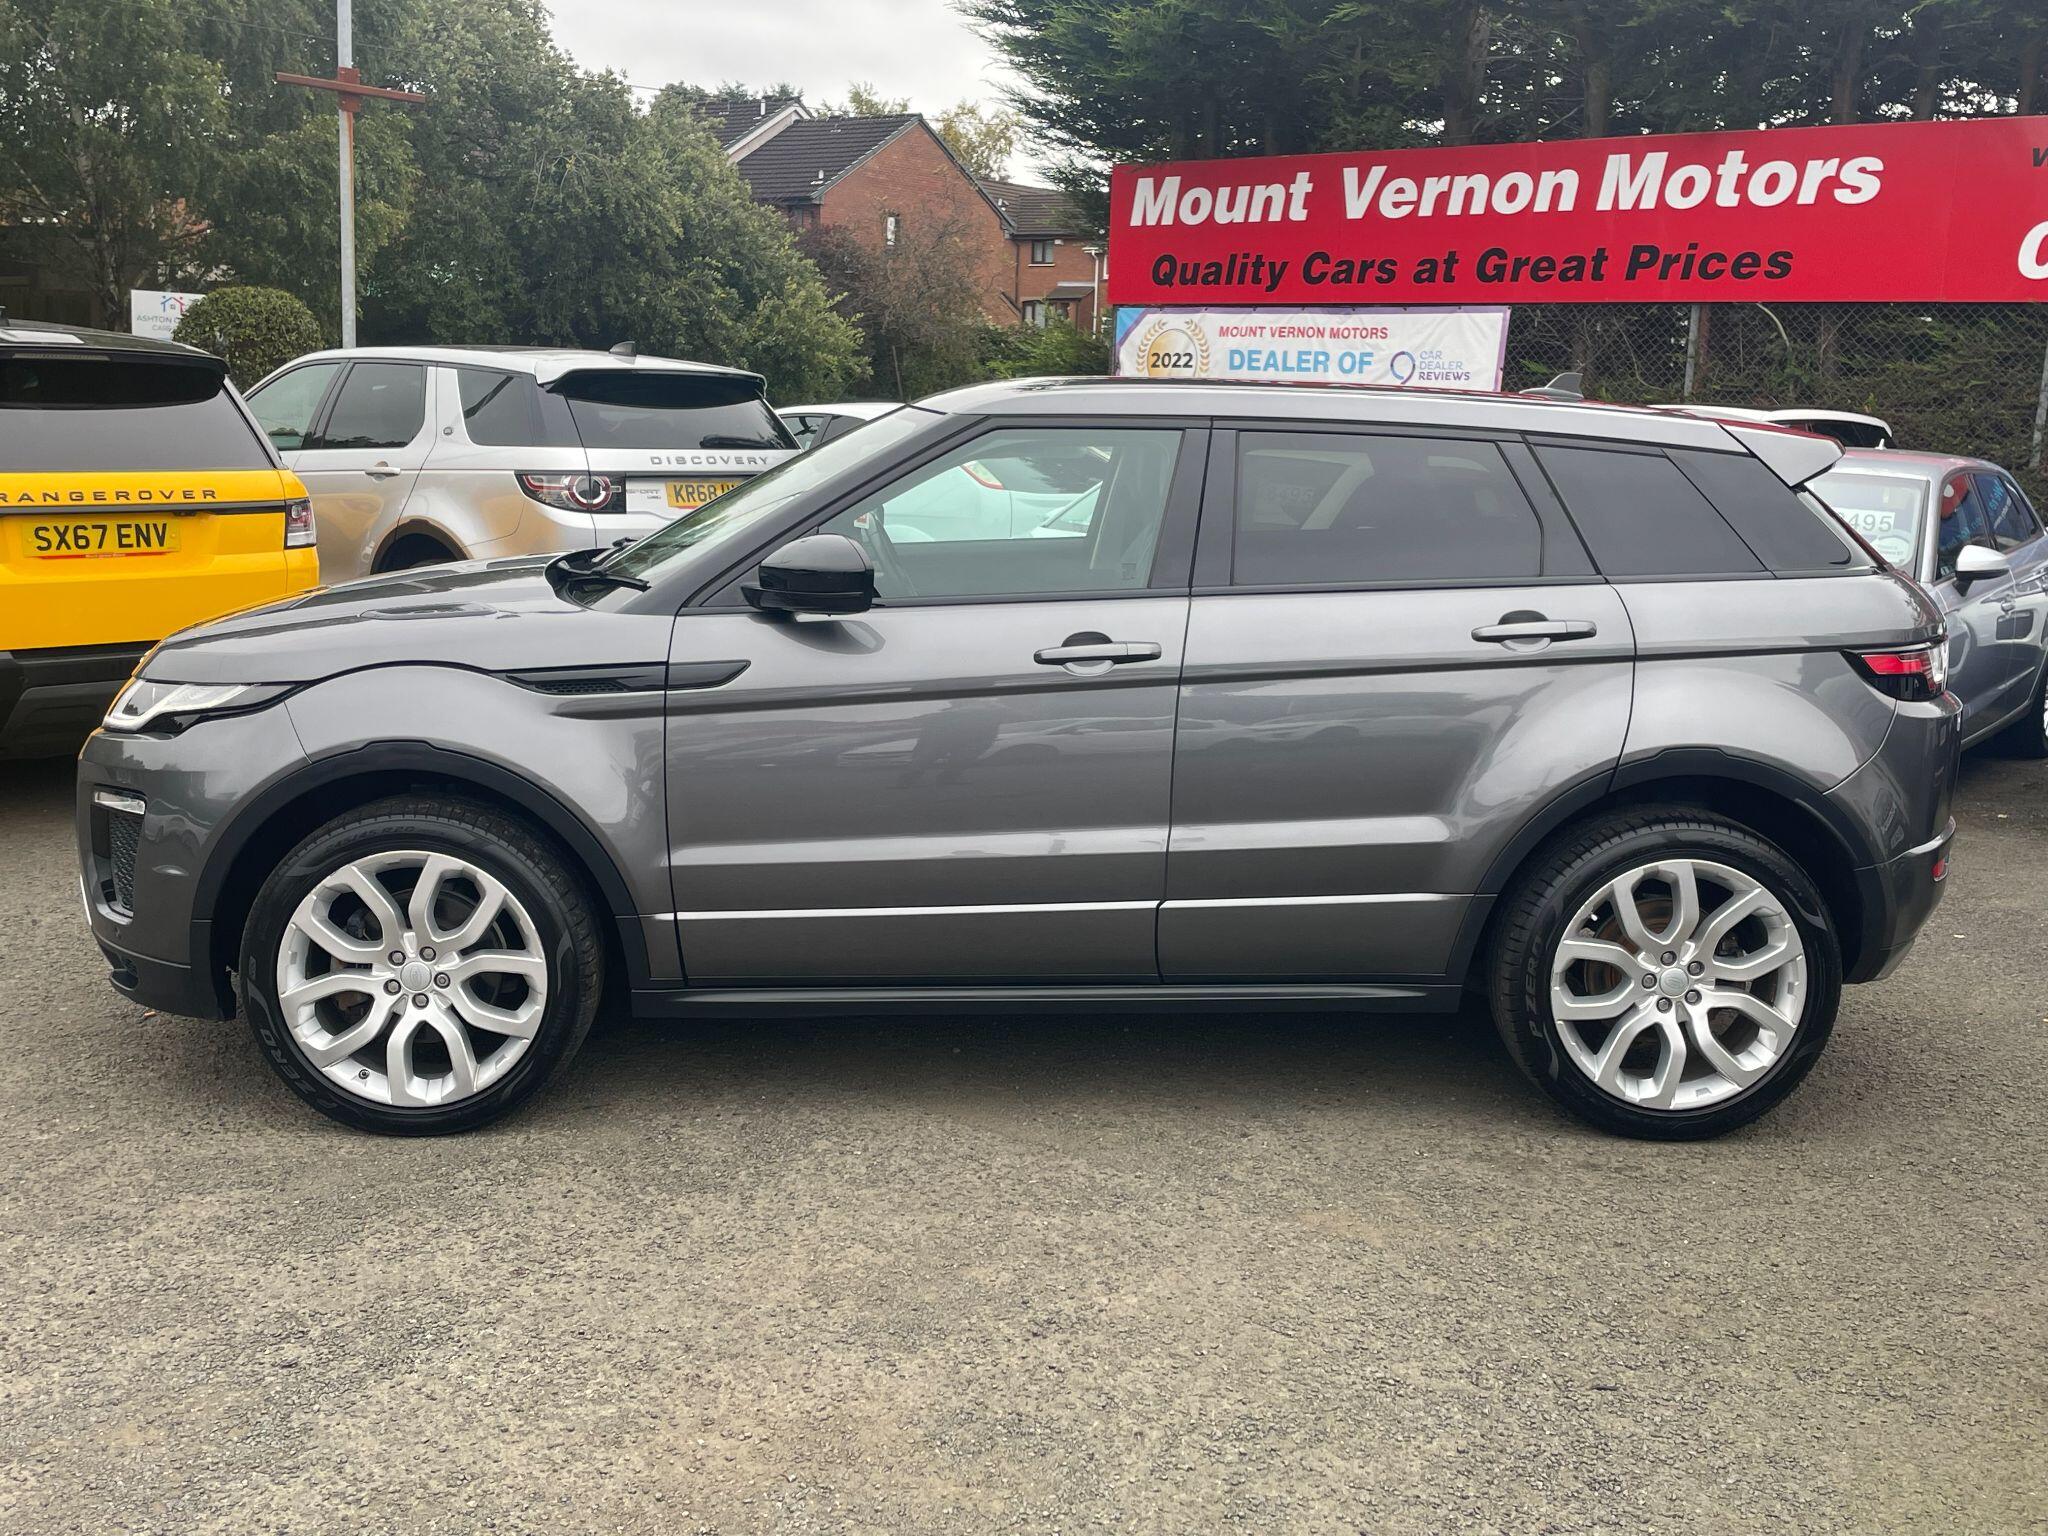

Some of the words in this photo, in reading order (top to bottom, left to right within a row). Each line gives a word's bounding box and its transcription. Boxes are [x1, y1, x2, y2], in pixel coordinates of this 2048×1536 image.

[1130, 171, 1313, 227] Mount
[1342, 166, 1580, 219] Vernon
[1596, 150, 1884, 212] Motors
[1151, 252, 1289, 292] Quality
[1302, 252, 1398, 285] Cars
[1412, 250, 1460, 283] at
[1475, 246, 1608, 283] Great
[1625, 242, 1794, 281] Prices
[1218, 325, 1266, 339] MOUNT
[1269, 326, 1324, 339] VERNON
[1328, 326, 1389, 340] MOTORS
[1150, 351, 1193, 369] 2022
[1228, 348, 1331, 373] DEALER
[1337, 352, 1374, 375] OF
[1419, 350, 1443, 360] CAR
[1419, 361, 1463, 370] DEALER
[1418, 371, 1471, 381] REVIEWS
[650, 456, 768, 465] DISCOVERY
[1839, 511, 1893, 532] 495
[34, 524, 108, 552] SX67
[116, 522, 168, 549] ENV
